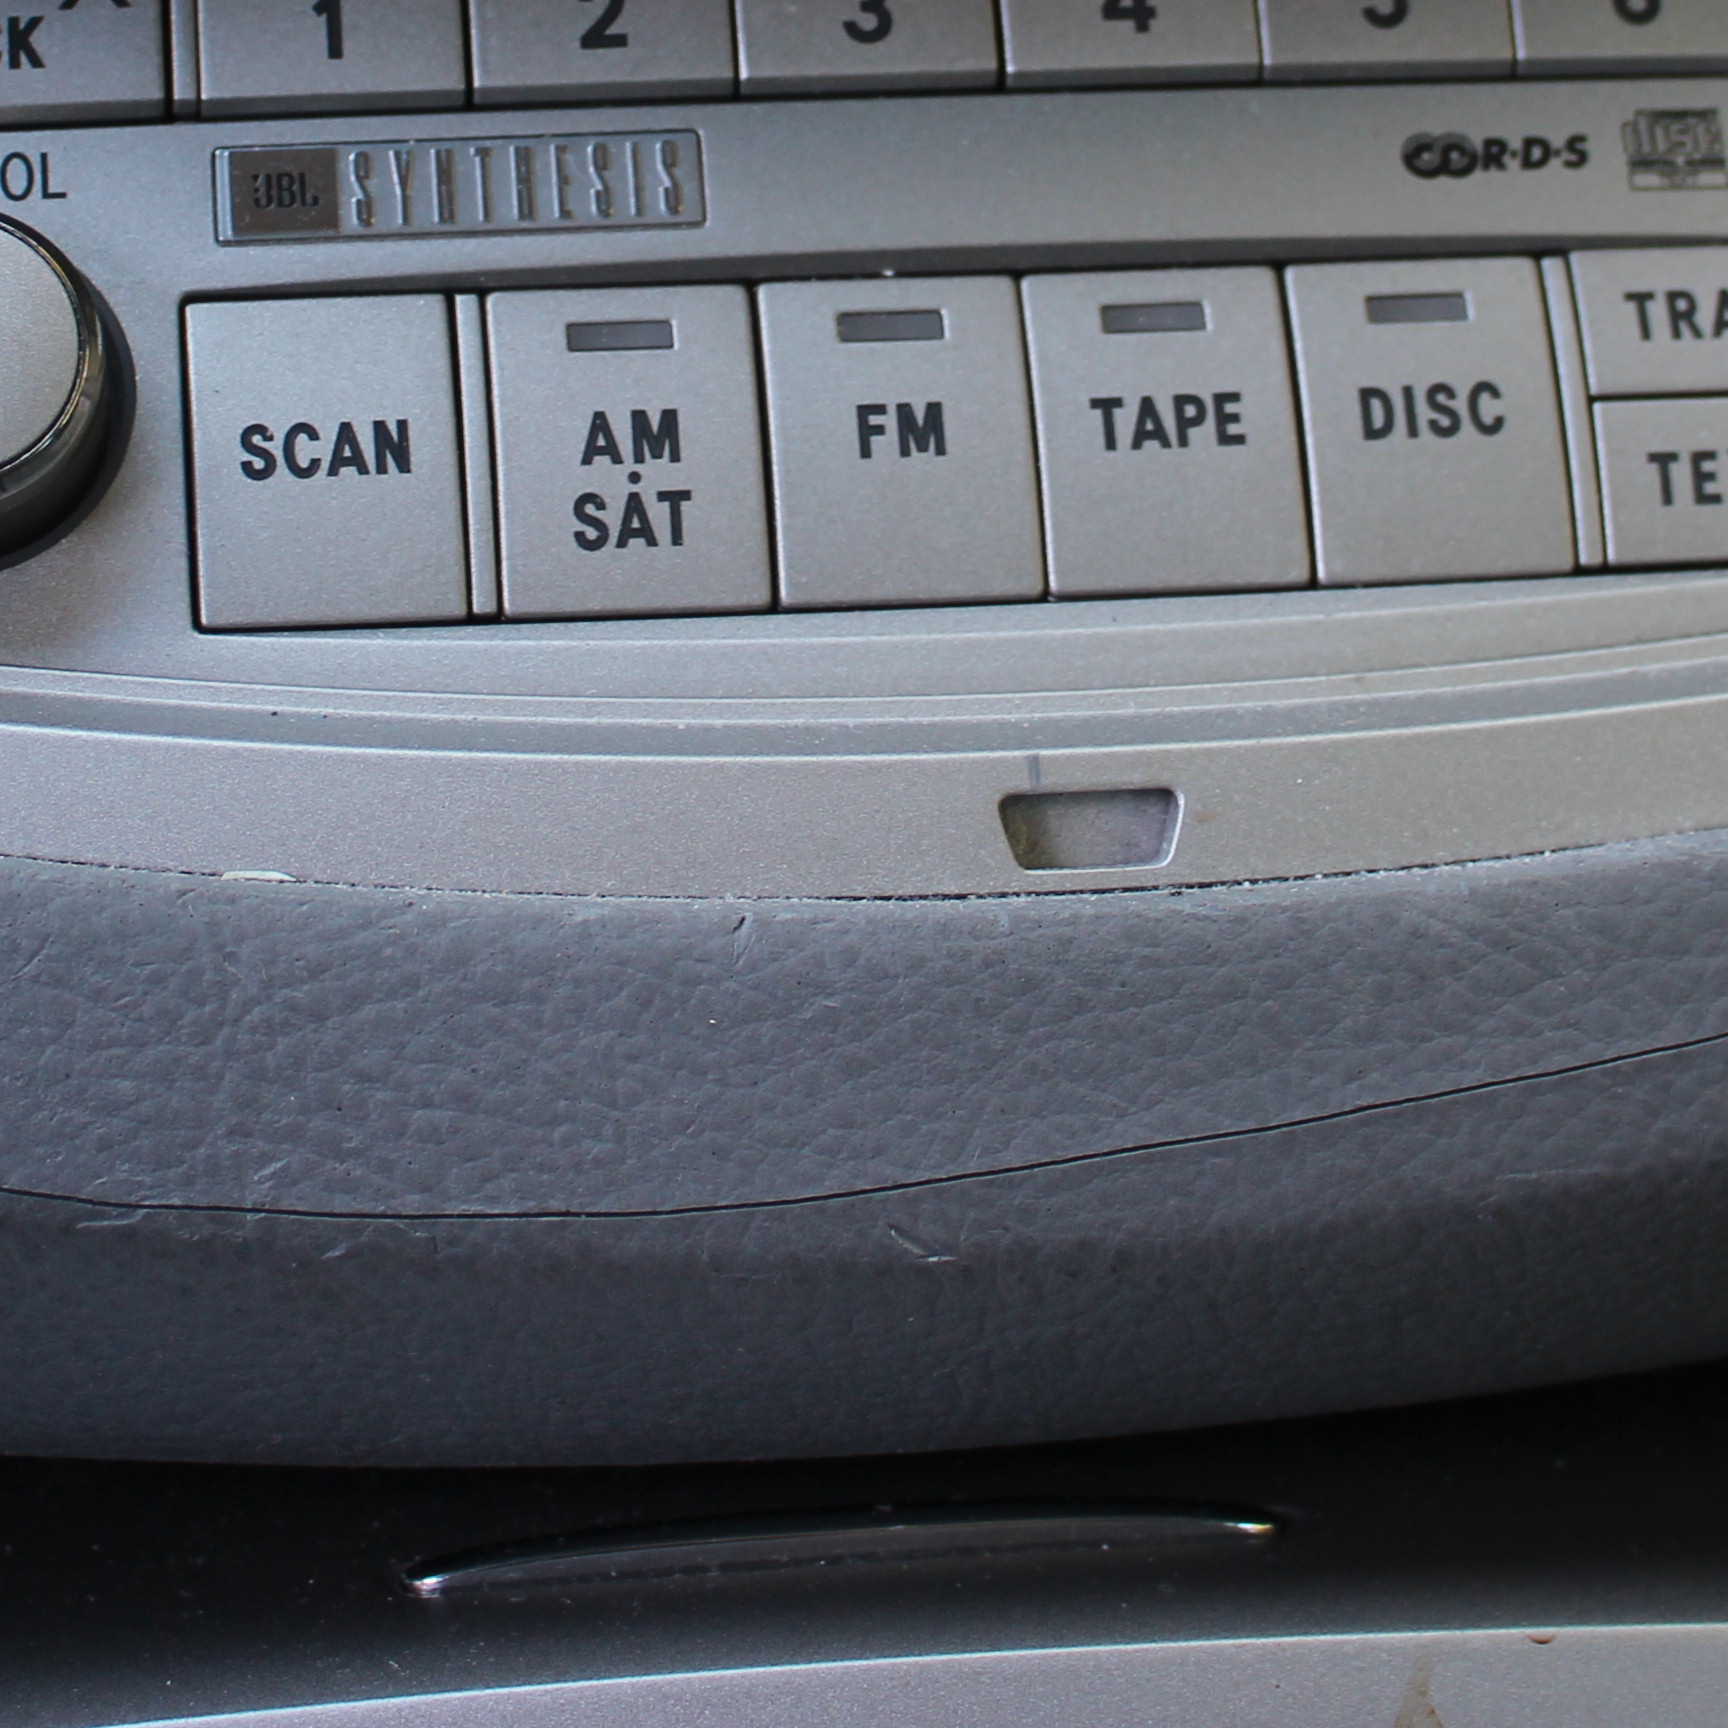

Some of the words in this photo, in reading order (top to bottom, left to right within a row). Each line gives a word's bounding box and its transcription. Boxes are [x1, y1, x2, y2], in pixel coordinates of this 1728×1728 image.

[251, 172, 320, 210] JBL
[348, 139, 685, 227] SYNTHESIS
[580, 408, 681, 466] AM
[855, 401, 947, 460] FM
[1089, 391, 1247, 452] TAPE
[1359, 380, 1507, 442] DISC
[239, 418, 412, 482] SCAN
[571, 489, 693, 553] SAT
